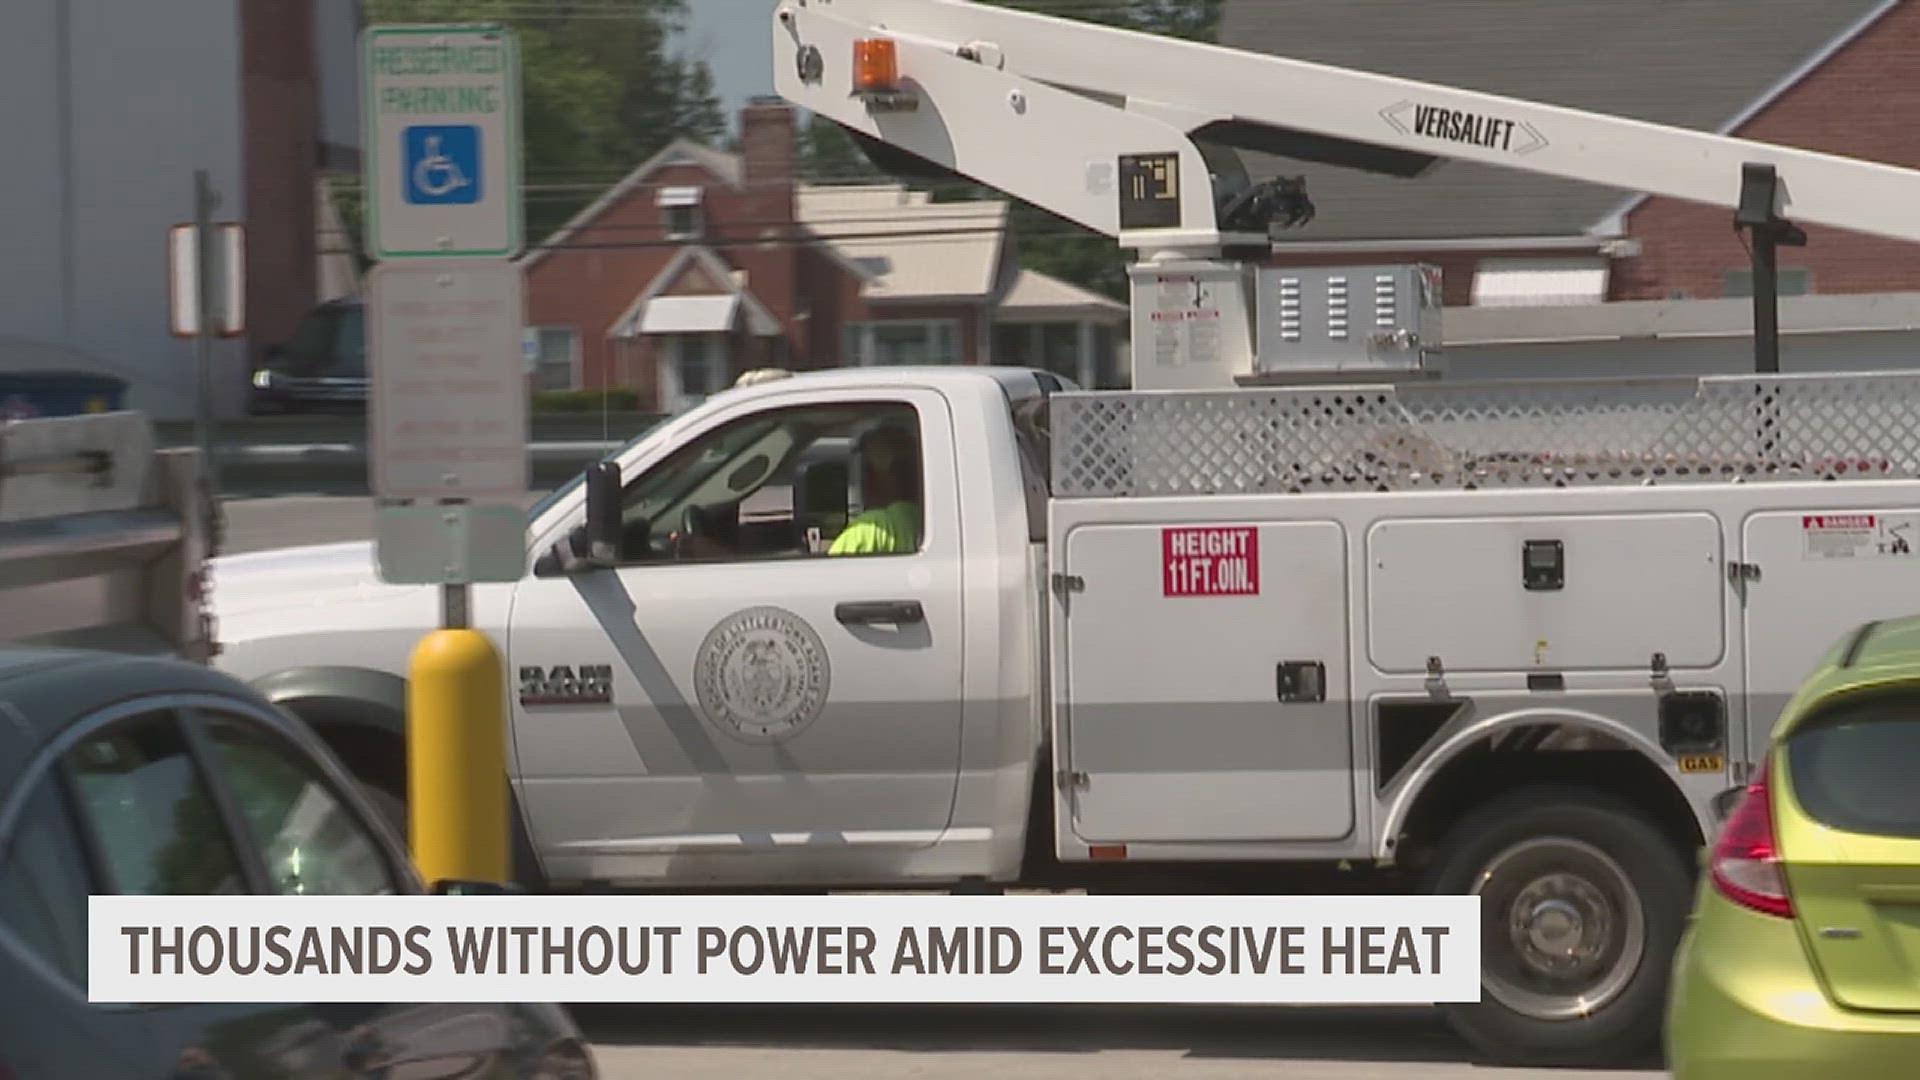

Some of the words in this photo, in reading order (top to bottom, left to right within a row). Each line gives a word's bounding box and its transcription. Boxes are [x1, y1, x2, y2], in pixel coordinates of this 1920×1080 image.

[369, 45, 506, 75] RESERVED
[380, 85, 499, 115] PARKING
[1413, 103, 1516, 151] VERSALIFT
[1171, 529, 1250, 556] HEIGHT
[713, 633, 728, 650] OF
[520, 665, 614, 682] RAM
[1685, 758, 1719, 771] GAS
